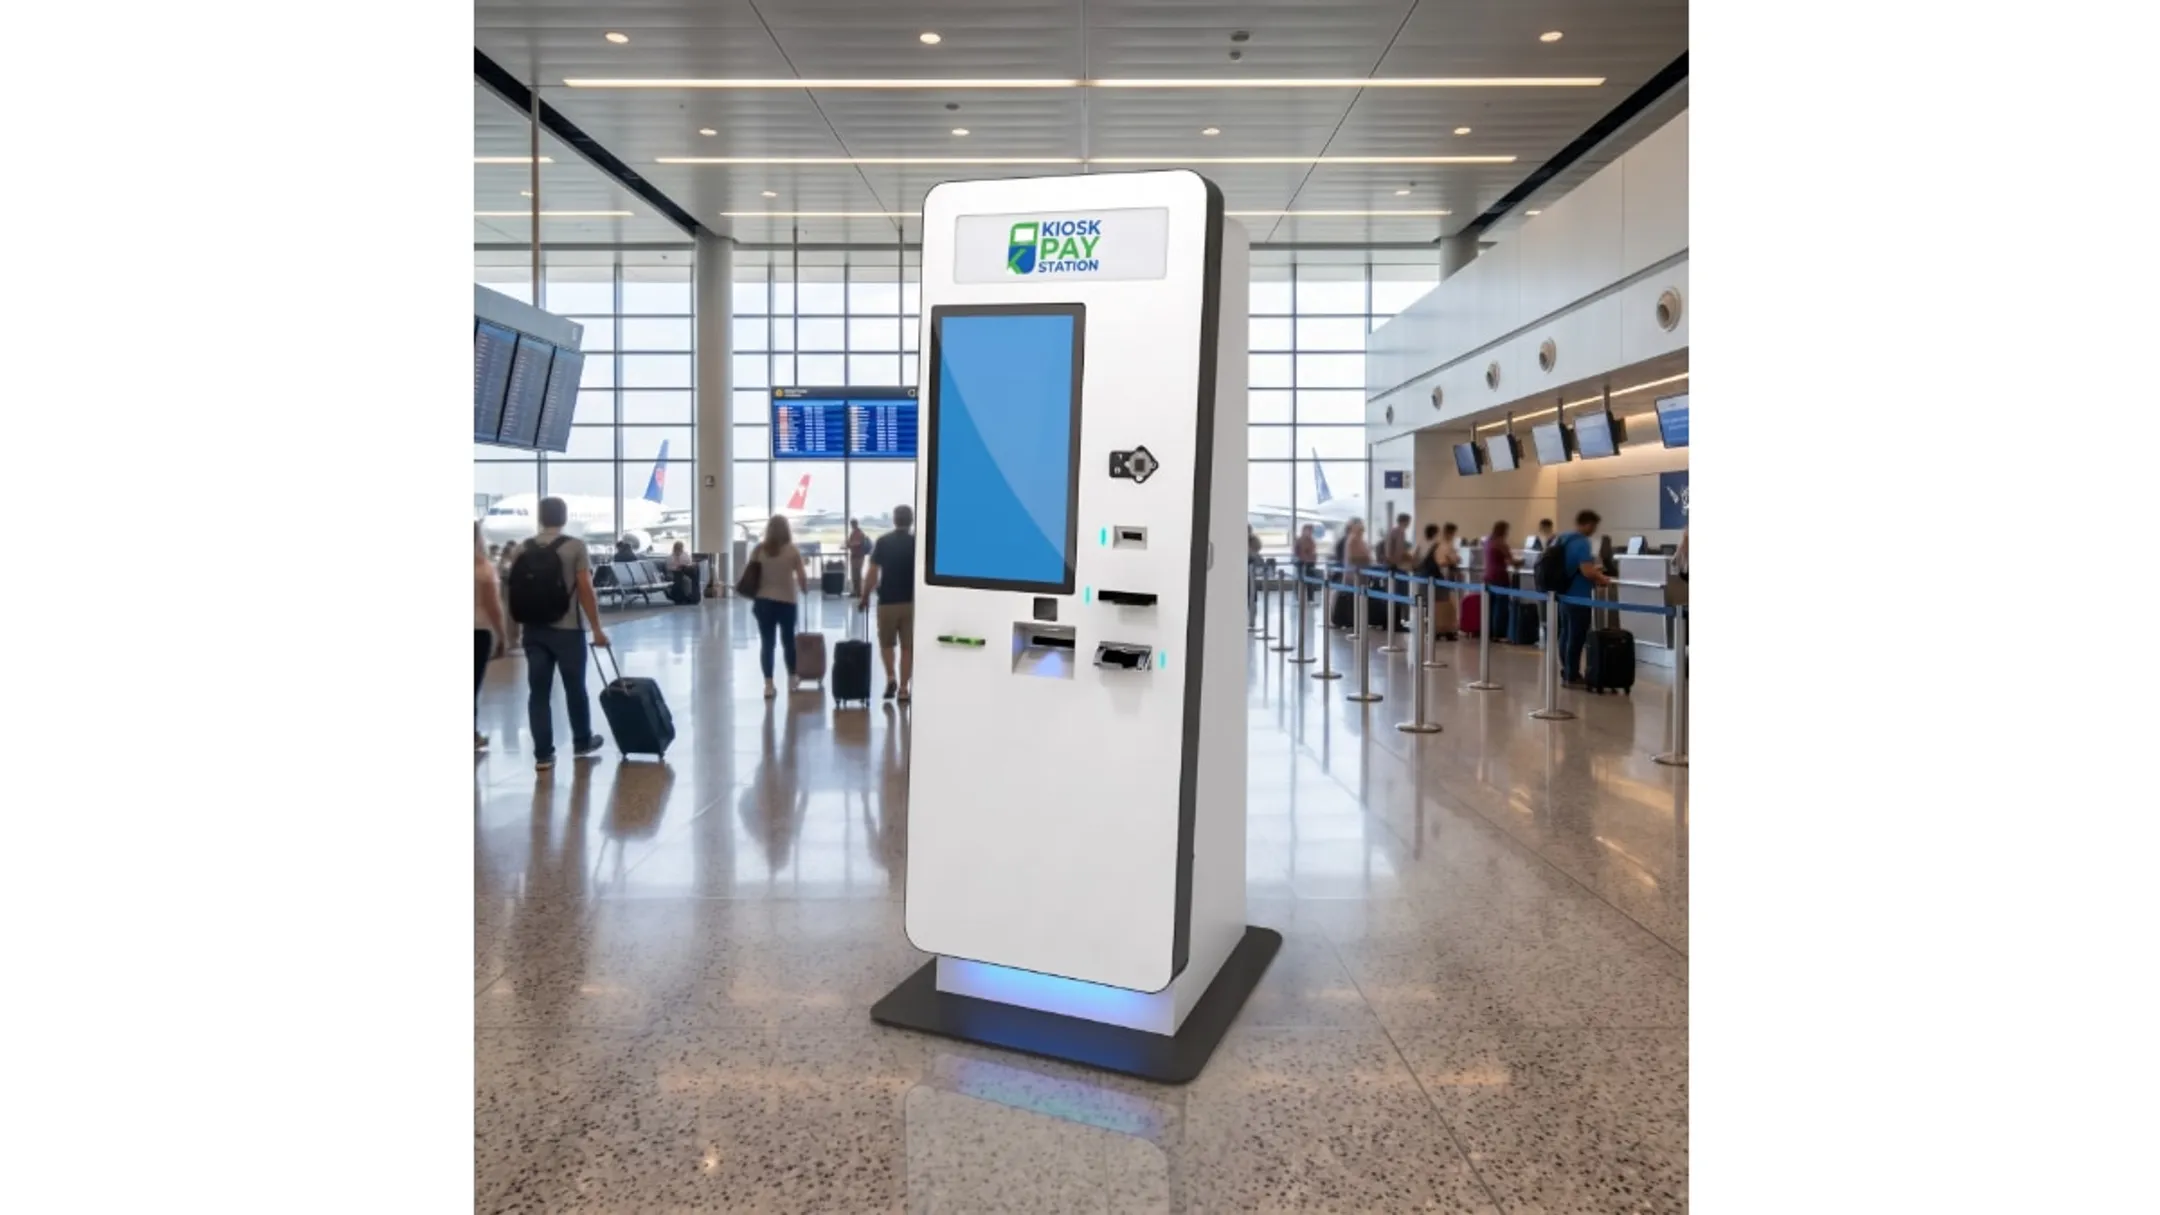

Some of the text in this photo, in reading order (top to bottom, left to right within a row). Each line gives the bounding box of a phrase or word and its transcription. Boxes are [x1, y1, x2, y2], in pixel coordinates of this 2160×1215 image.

[1042, 220, 1101, 236] KIOSK
[1041, 237, 1100, 260] PAY
[1038, 260, 1099, 273] STATION
